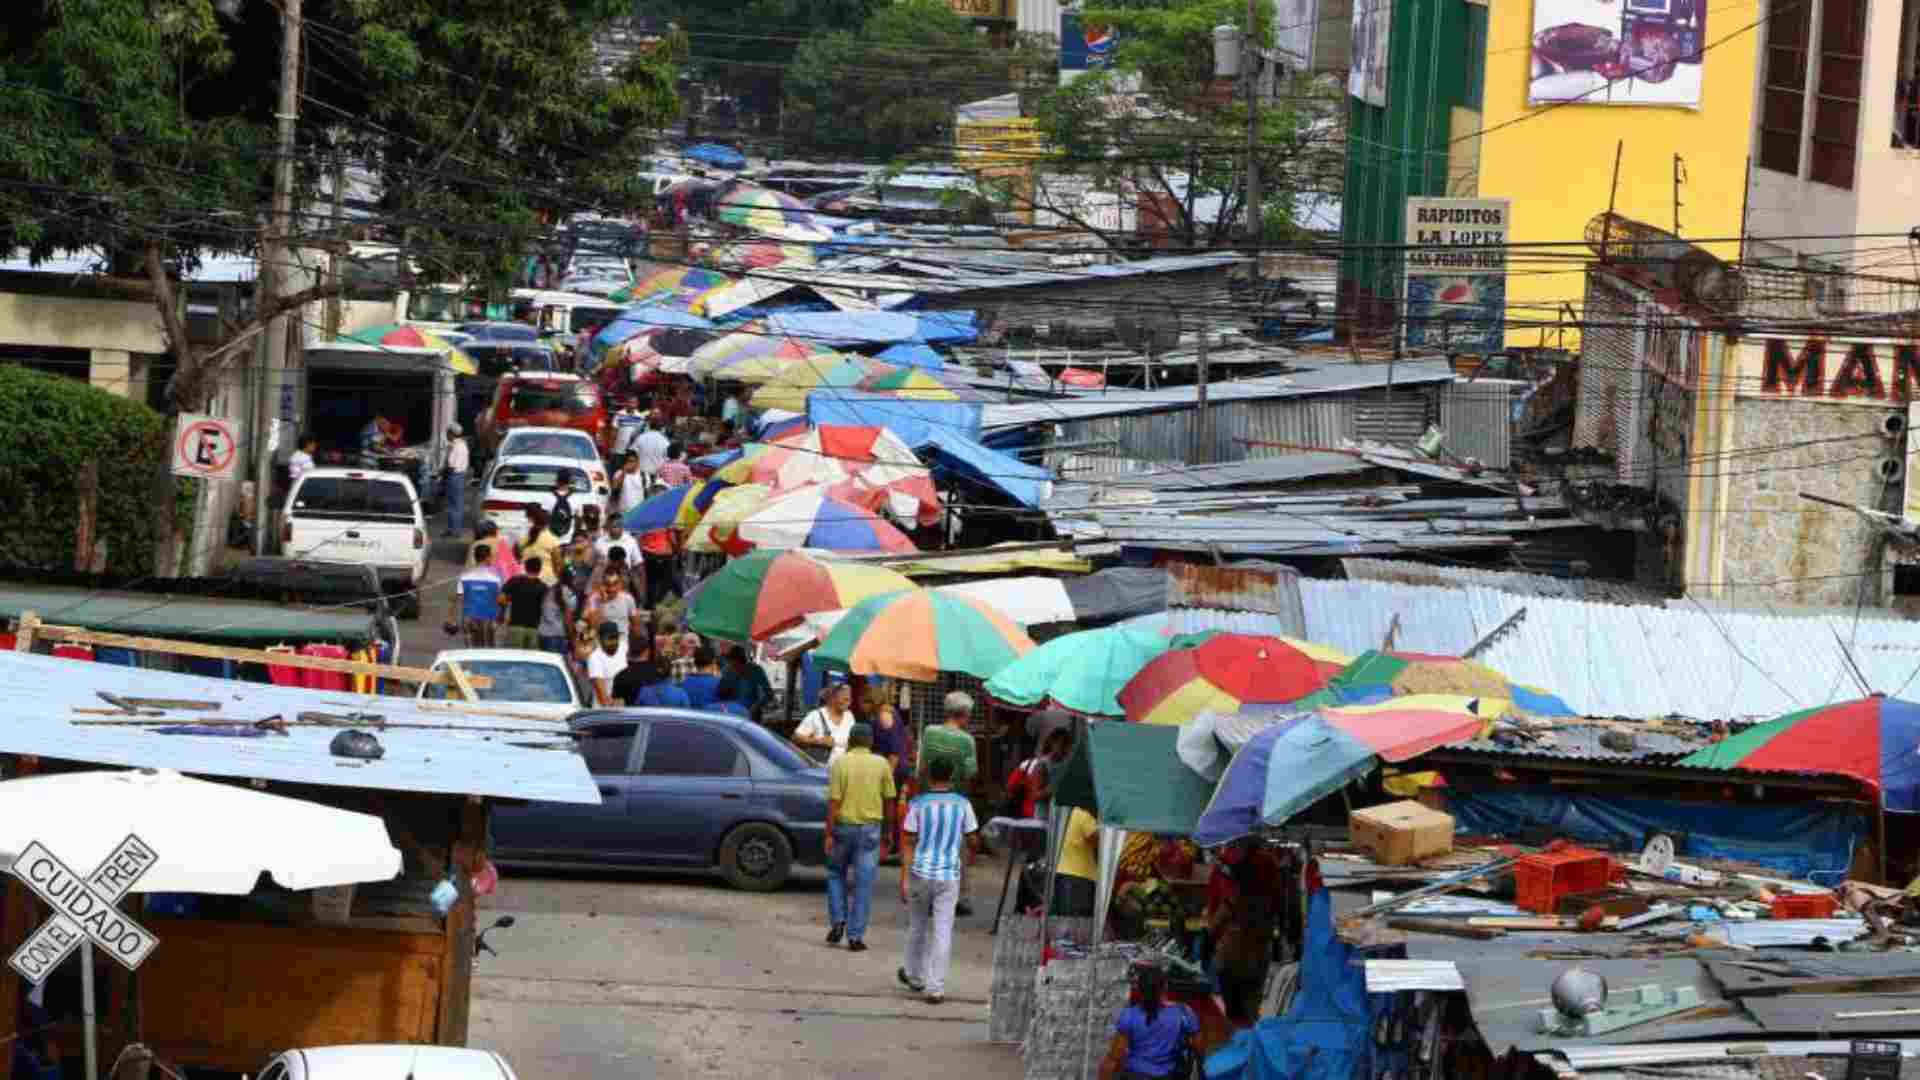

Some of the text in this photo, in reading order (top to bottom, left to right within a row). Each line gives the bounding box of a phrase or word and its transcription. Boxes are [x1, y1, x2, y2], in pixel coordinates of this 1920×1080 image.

[1417, 207, 1501, 224] RAPIDITOS
[1417, 230, 1503, 245] LA LOPEZ
[94, 842, 149, 895] TREN
[30, 858, 141, 955] CUIDADO
[20, 925, 77, 975] CON EL
